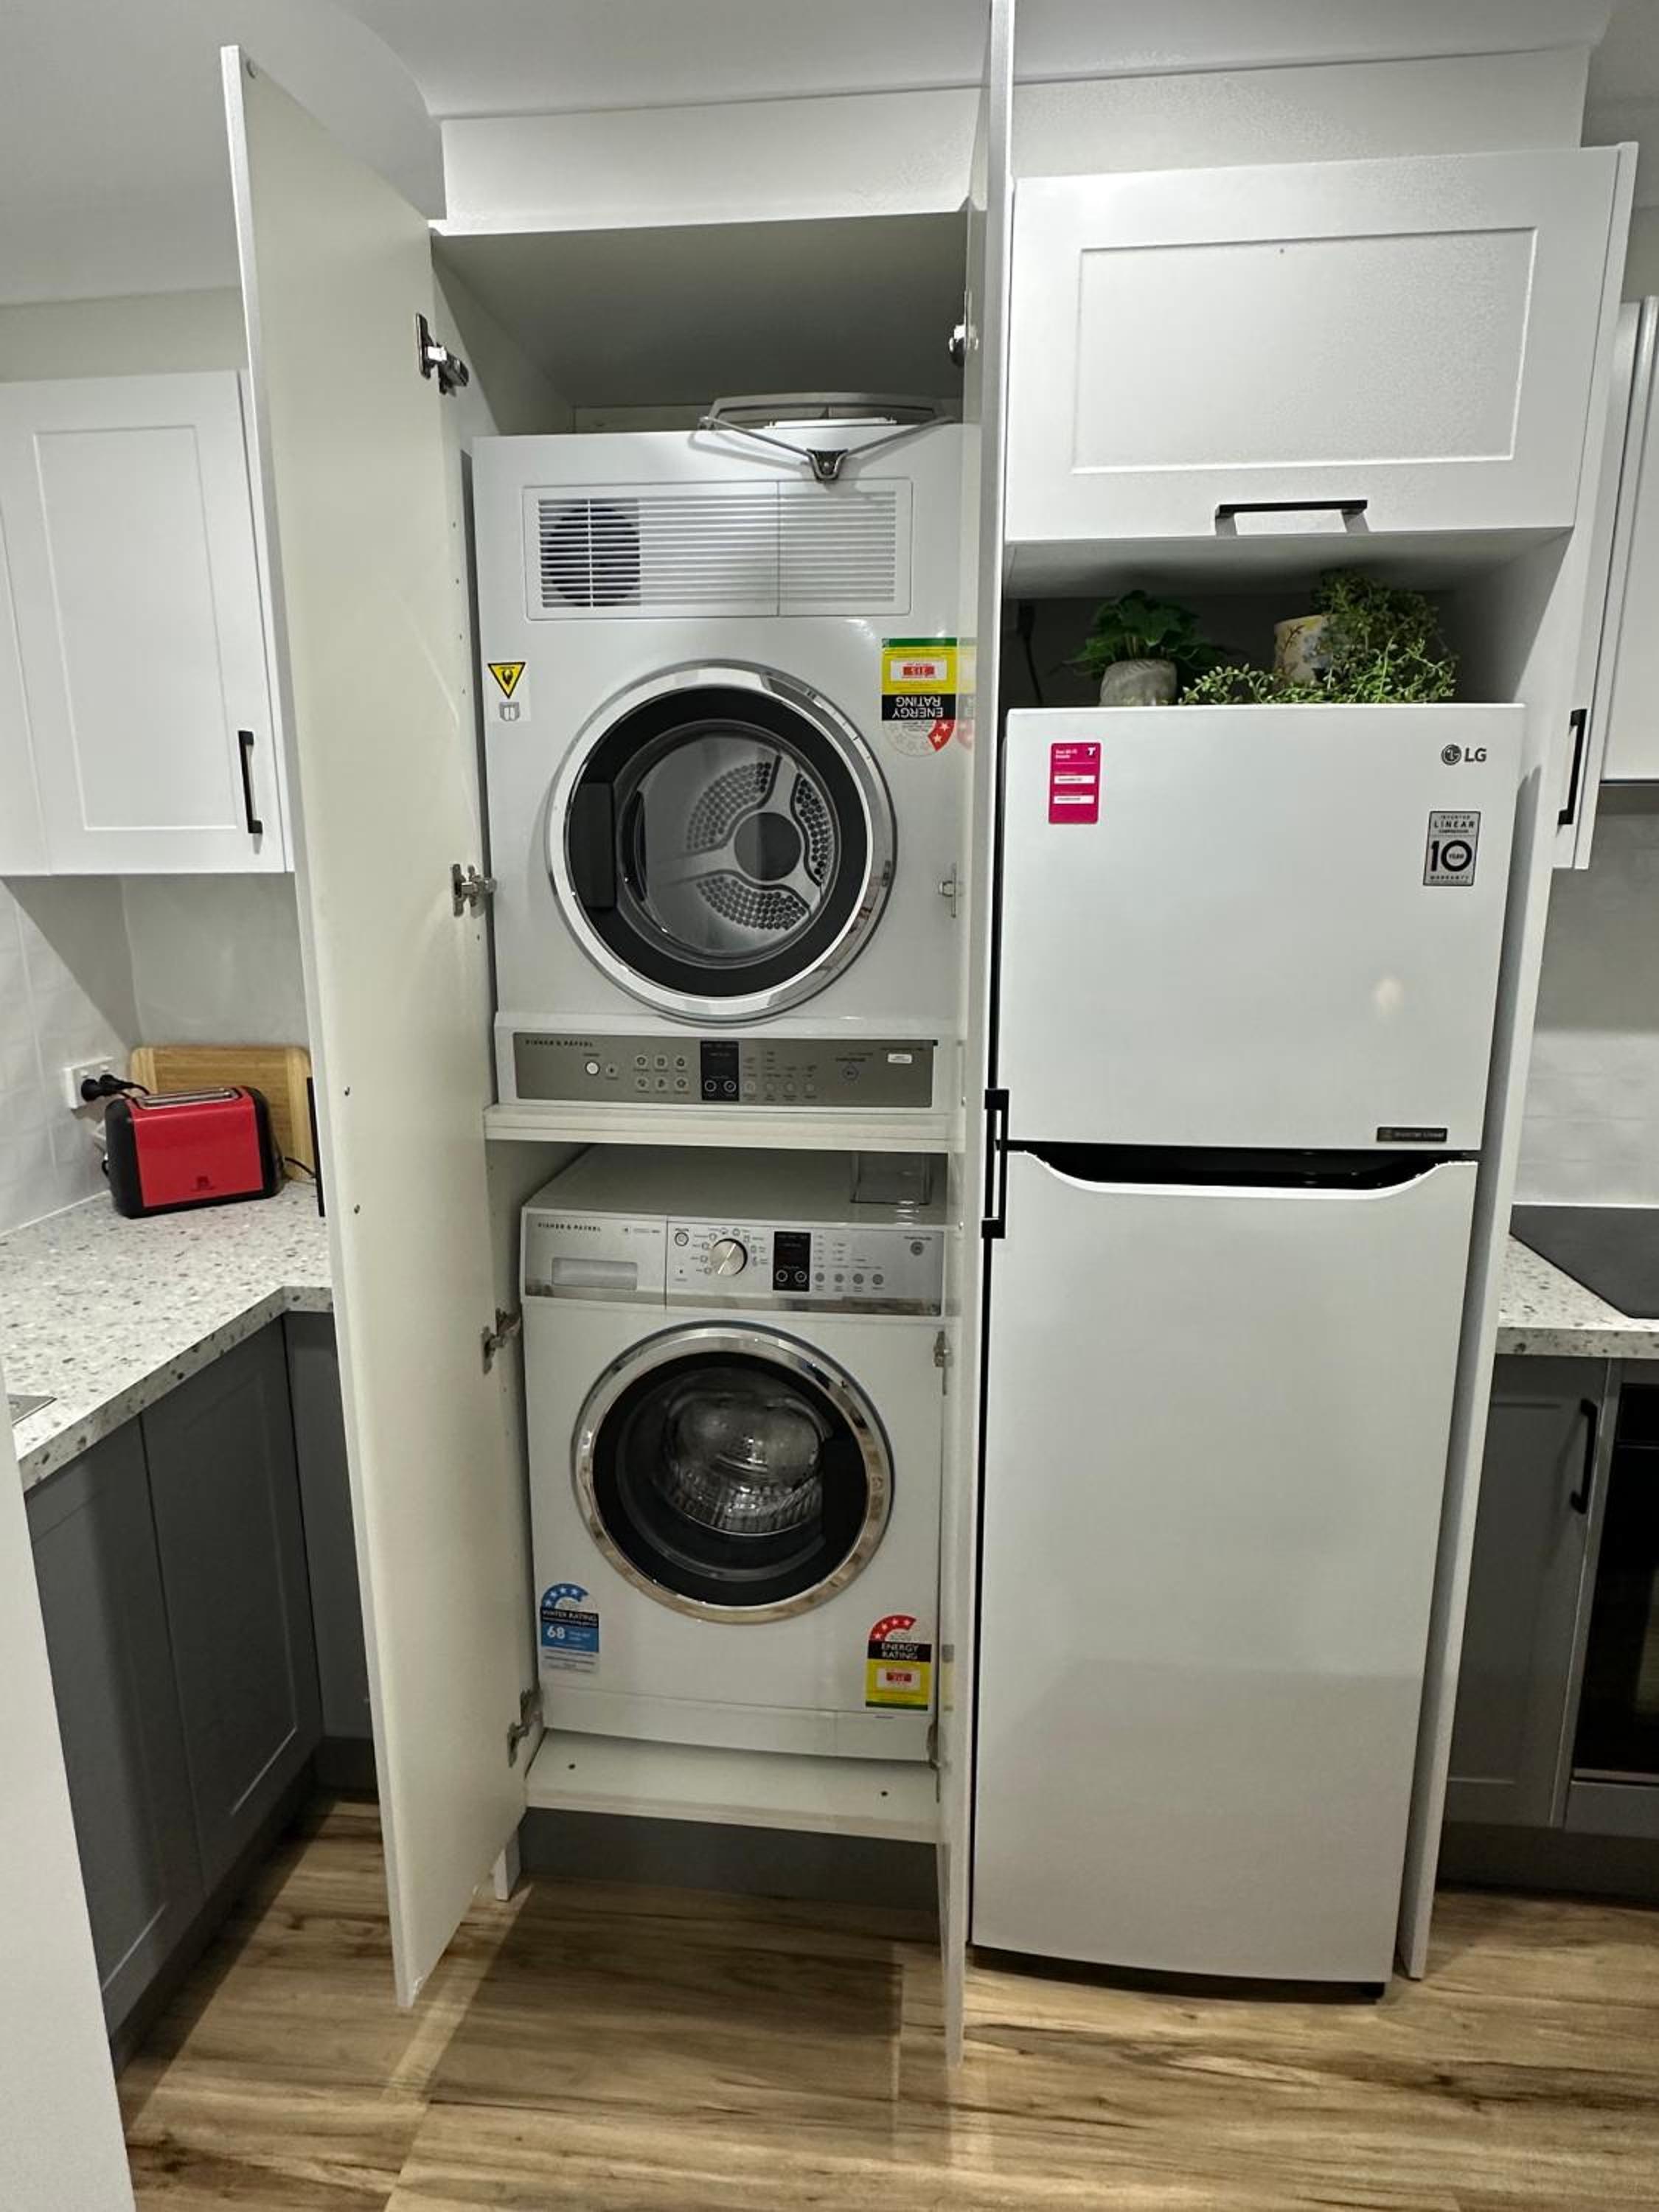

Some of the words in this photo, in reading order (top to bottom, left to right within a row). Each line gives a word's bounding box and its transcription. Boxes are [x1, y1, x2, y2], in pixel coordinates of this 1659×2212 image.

[895, 695, 942, 707] RATING
[891, 707, 944, 719] ENERGY
[1464, 747, 1487, 763] LG
[1433, 820, 1475, 829] LINEAR
[1430, 839, 1473, 873] 10
[546, 1625, 566, 1640] 68
[881, 1642, 919, 1652] ENERGY
[882, 1651, 919, 1660] RATING
